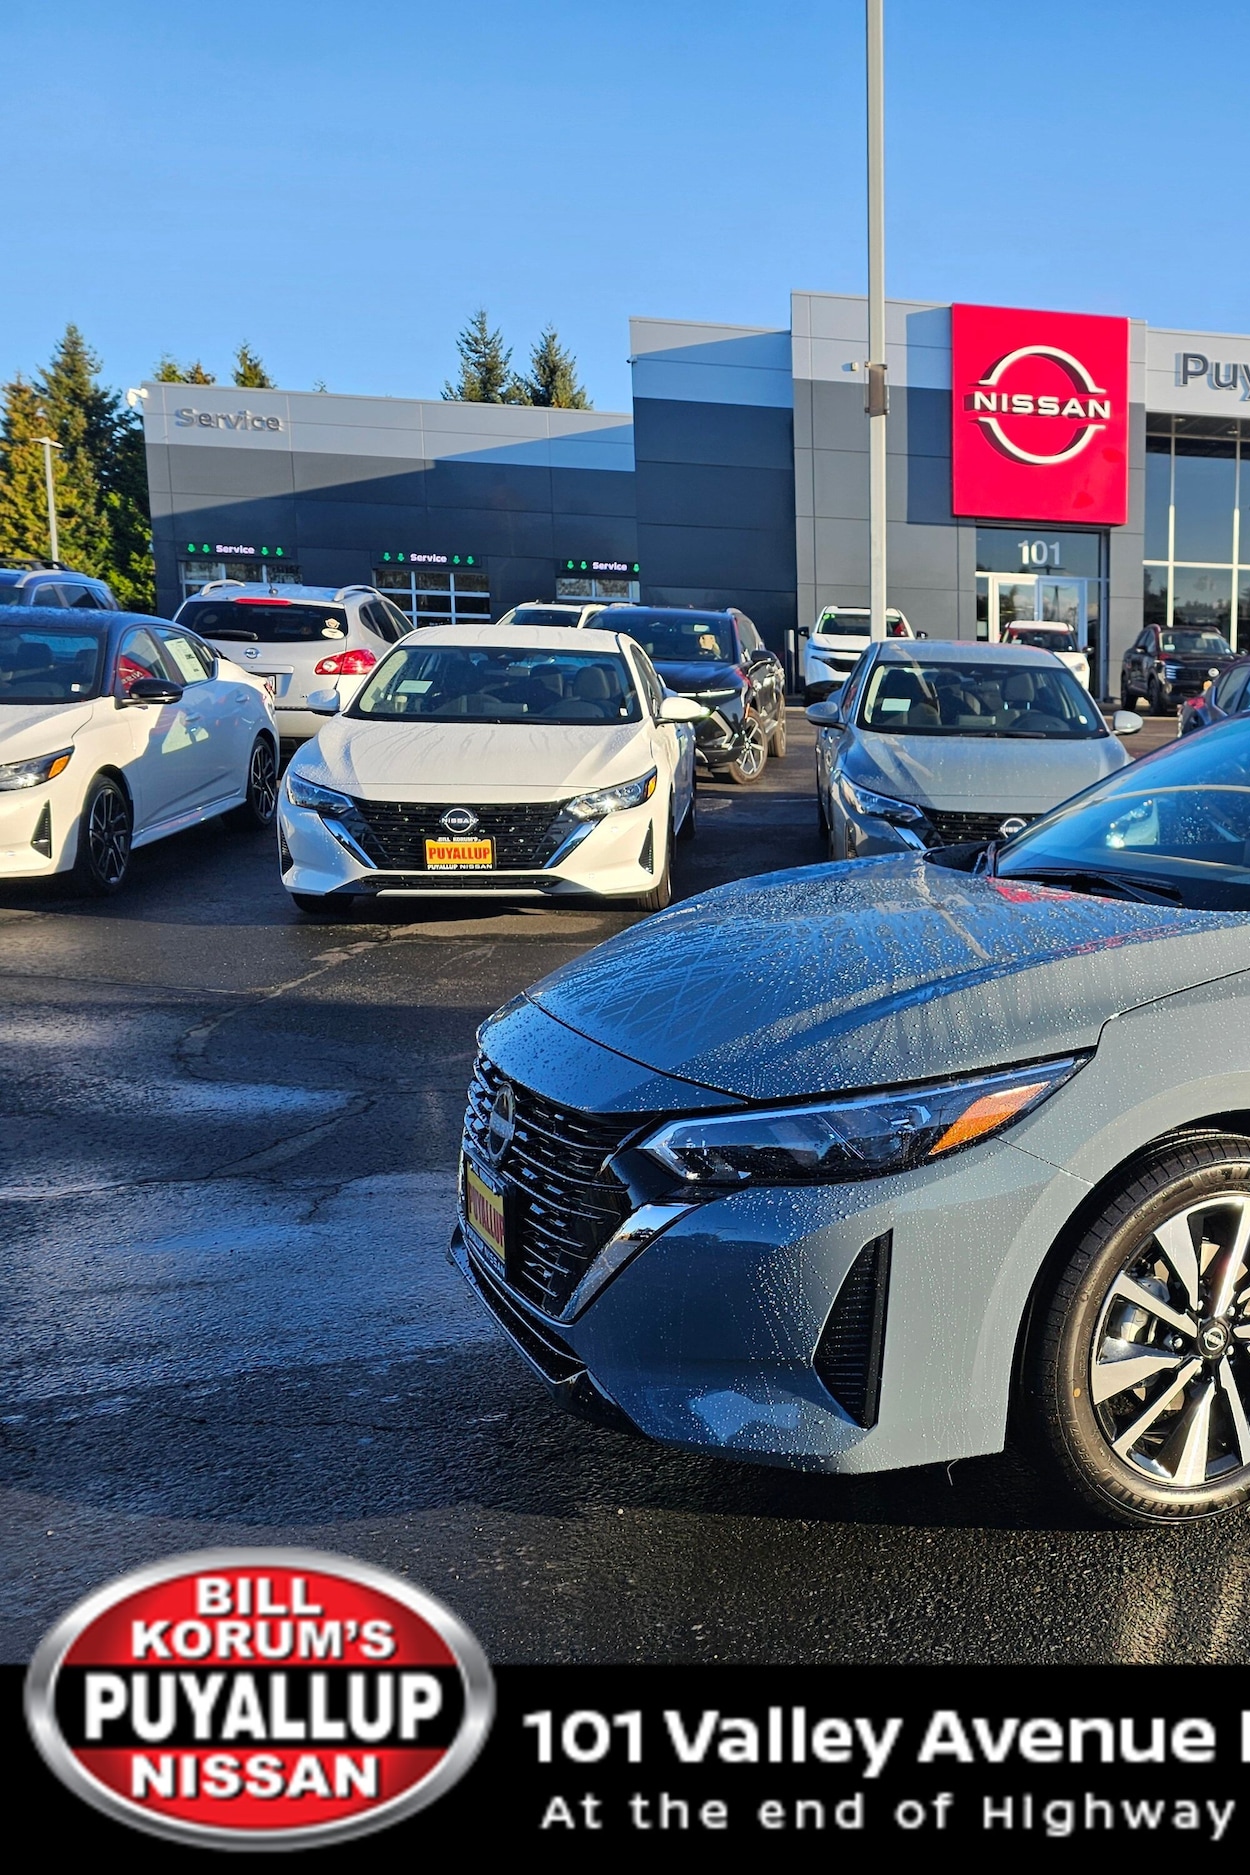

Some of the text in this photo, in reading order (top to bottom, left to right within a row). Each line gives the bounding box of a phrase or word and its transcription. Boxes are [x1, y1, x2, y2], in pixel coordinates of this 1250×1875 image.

[973, 391, 1110, 419] NISSAN
[176, 408, 282, 431] Service
[215, 544, 256, 554] Service
[409, 553, 448, 563] Service
[1018, 540, 1061, 565] 101
[592, 561, 628, 571] Service
[428, 847, 491, 860] PUYALLUP
[467, 1180, 505, 1248] PUYALLUP
[1106, 1480, 1211, 1518] MICHELIN
